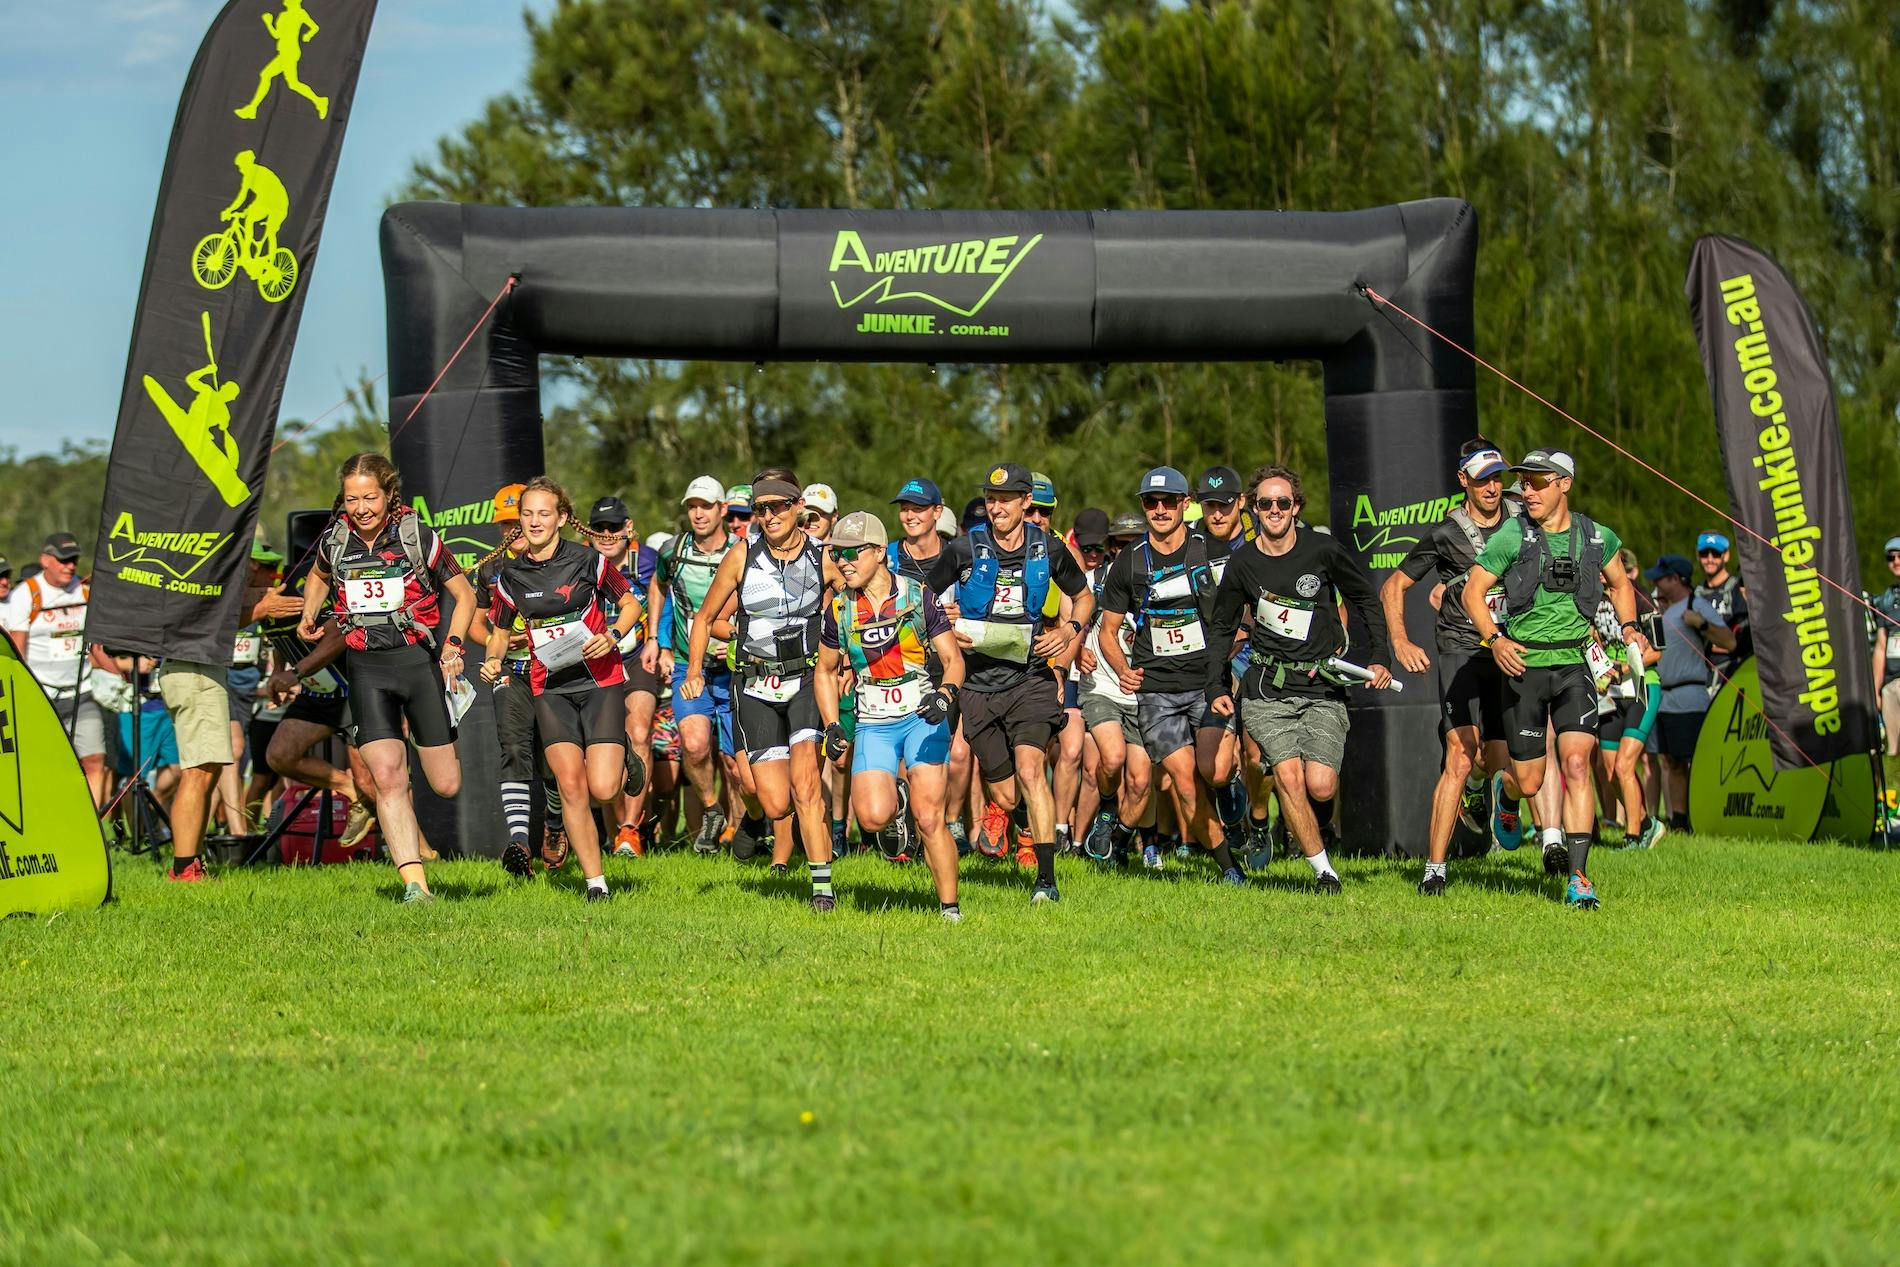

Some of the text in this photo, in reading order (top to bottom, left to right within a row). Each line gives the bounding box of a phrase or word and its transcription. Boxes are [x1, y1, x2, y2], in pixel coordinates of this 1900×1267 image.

[829, 230, 1019, 274] ADVENTURE
[1719, 273, 1841, 736] adventurejunkie.com.au
[109, 511, 221, 557] ADVENTURE
[117, 566, 164, 588] JUNKIE
[363, 581, 385, 599] 33
[1488, 596, 1506, 612] 47
[1277, 608, 1289, 624] 4
[863, 626, 895, 642] GU
[1166, 629, 1184, 645] 15
[64, 638, 77, 651] 57
[880, 687, 903, 704] 70
[1519, 729, 1543, 738] 2XU
